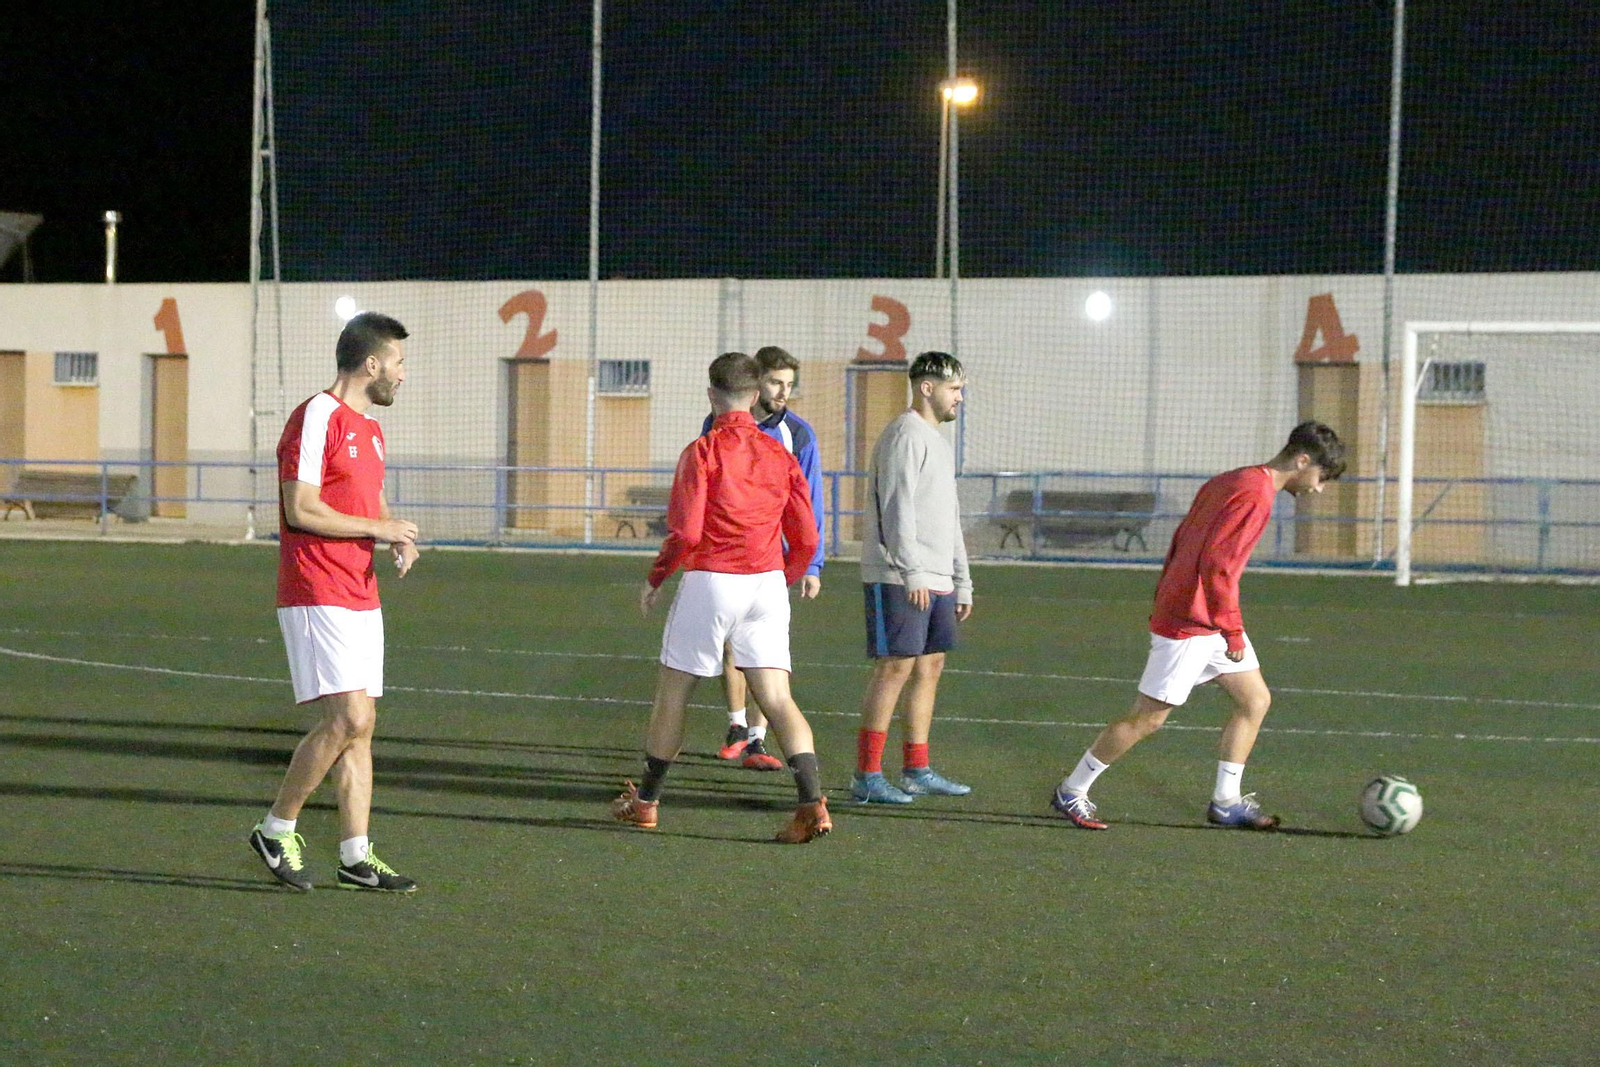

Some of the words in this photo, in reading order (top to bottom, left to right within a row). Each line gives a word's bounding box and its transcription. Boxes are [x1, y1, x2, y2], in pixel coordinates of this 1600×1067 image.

[154, 297, 187, 354] 1
[498, 289, 558, 358] 2
[857, 294, 911, 360] 3
[1294, 292, 1360, 362] 4
